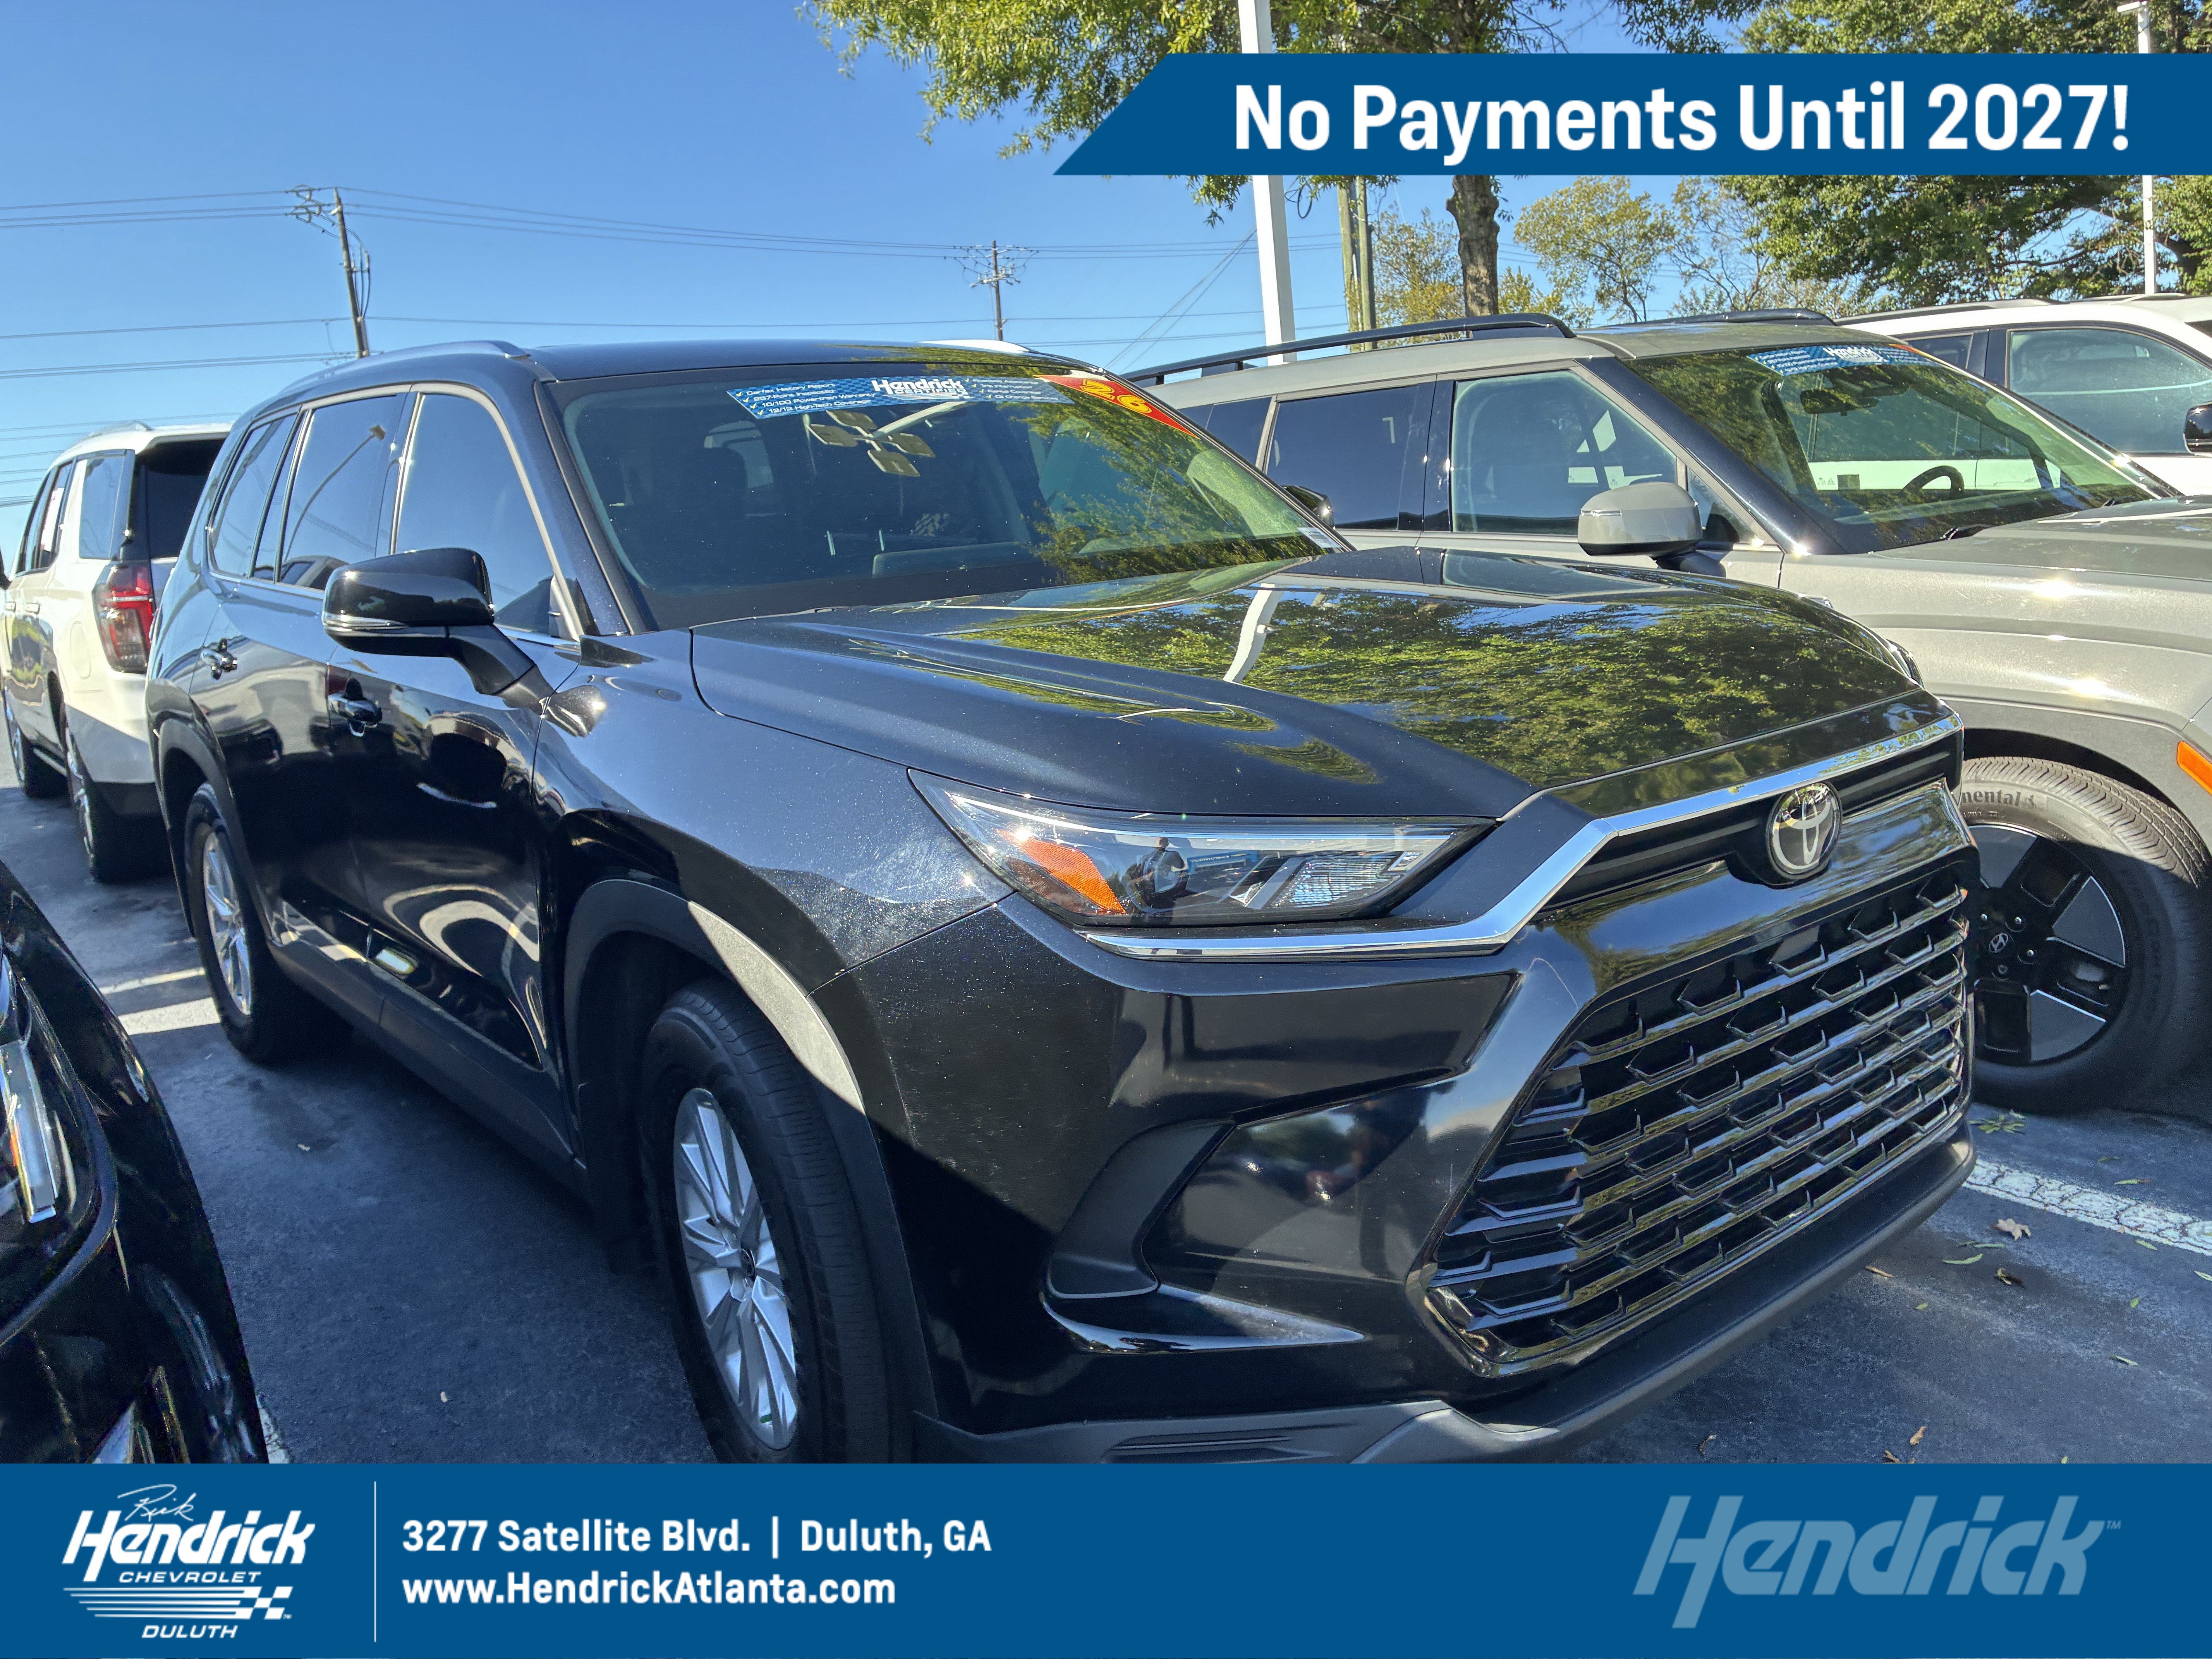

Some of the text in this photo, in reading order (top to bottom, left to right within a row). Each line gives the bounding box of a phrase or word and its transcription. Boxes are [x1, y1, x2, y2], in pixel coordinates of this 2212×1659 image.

[871, 378, 964, 394] Hendrick
[793, 395, 838, 403] Powertrain
[1079, 379, 1152, 413] 26
[1962, 790, 2021, 806] nental
